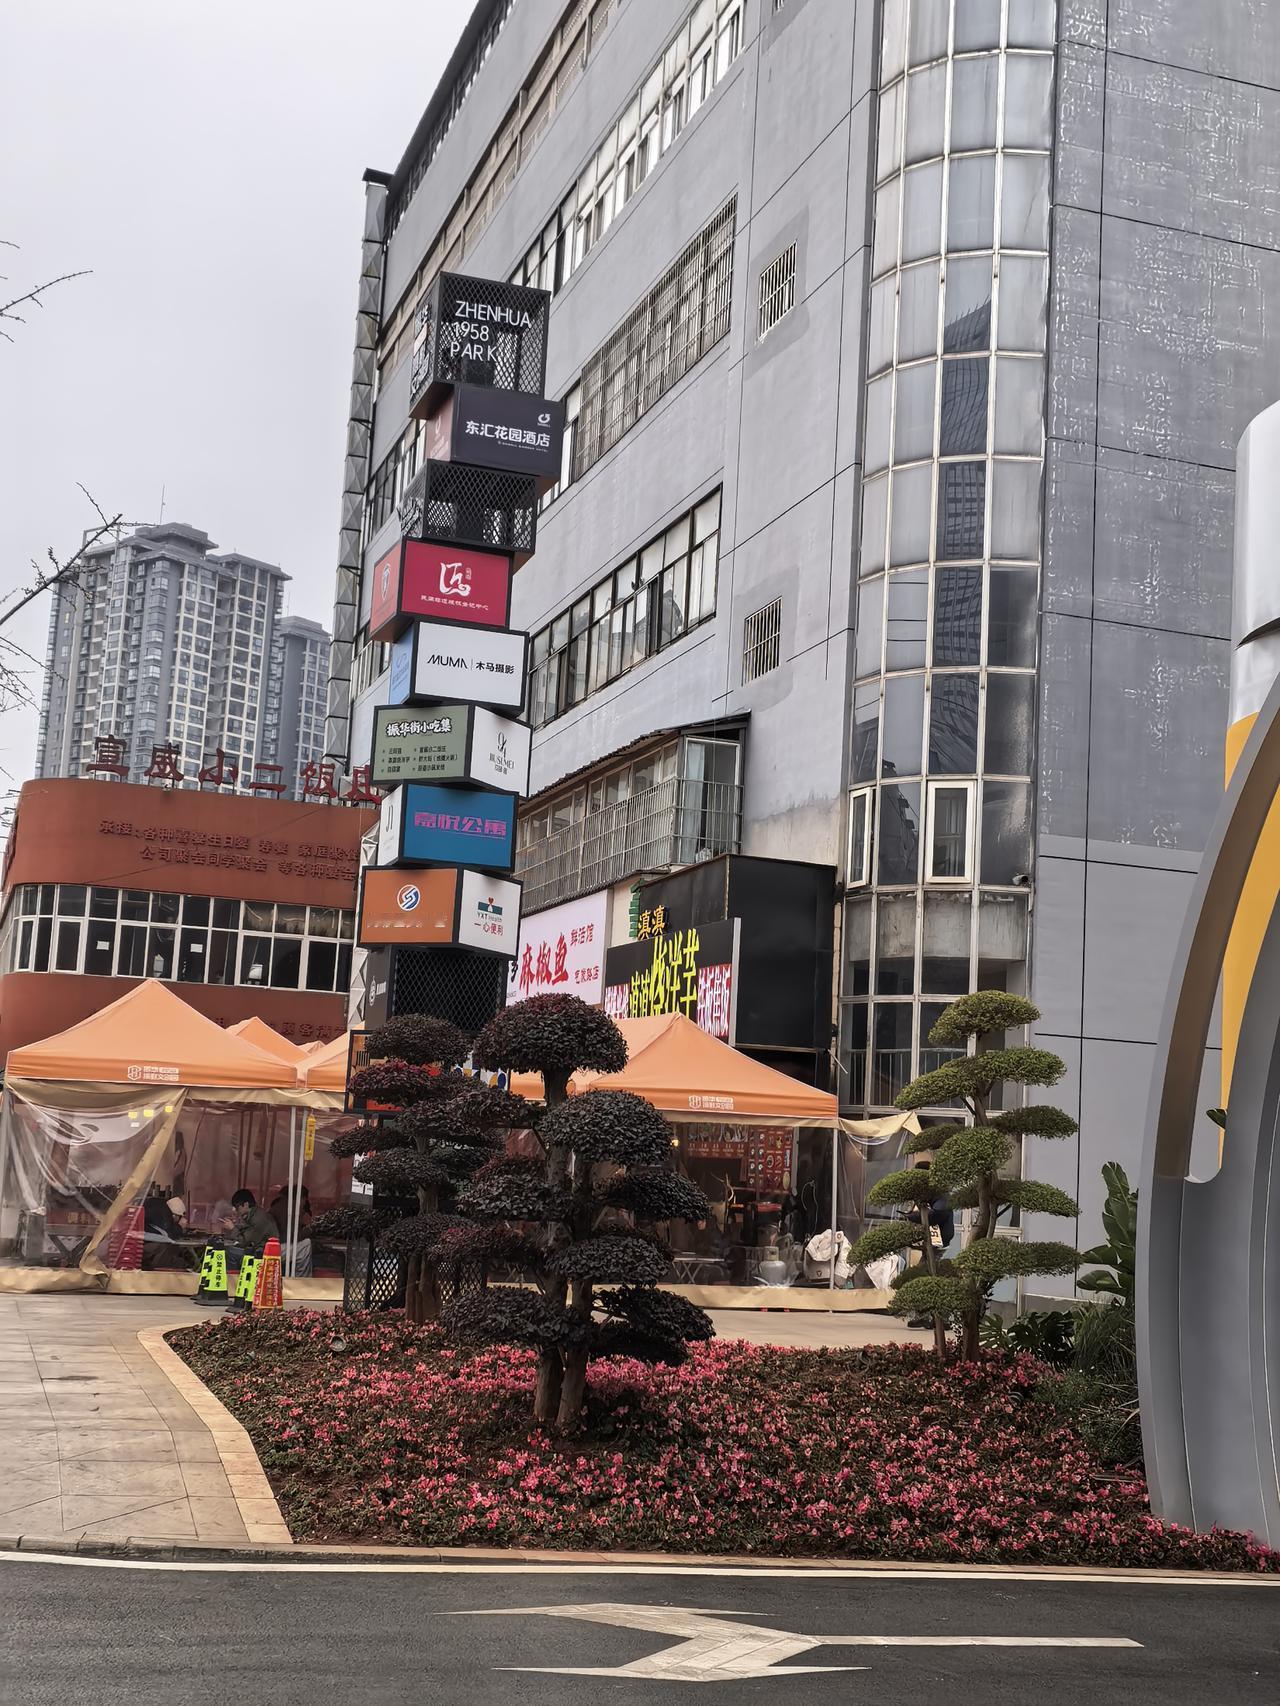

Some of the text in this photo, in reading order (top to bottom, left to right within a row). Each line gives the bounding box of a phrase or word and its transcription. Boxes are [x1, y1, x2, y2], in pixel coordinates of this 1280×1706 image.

[455, 301, 531, 327] ZHENHUA
[454, 321, 489, 341] 1958
[450, 342, 498, 362] PARK
[465, 420, 551, 447] 东汇花园酒店
[476, 662, 515, 675] 木马摄影
[386, 717, 452, 737] 振华街小吃集
[474, 922, 504, 936] 一心便利
[519, 932, 569, 997] 麻椒鱼
